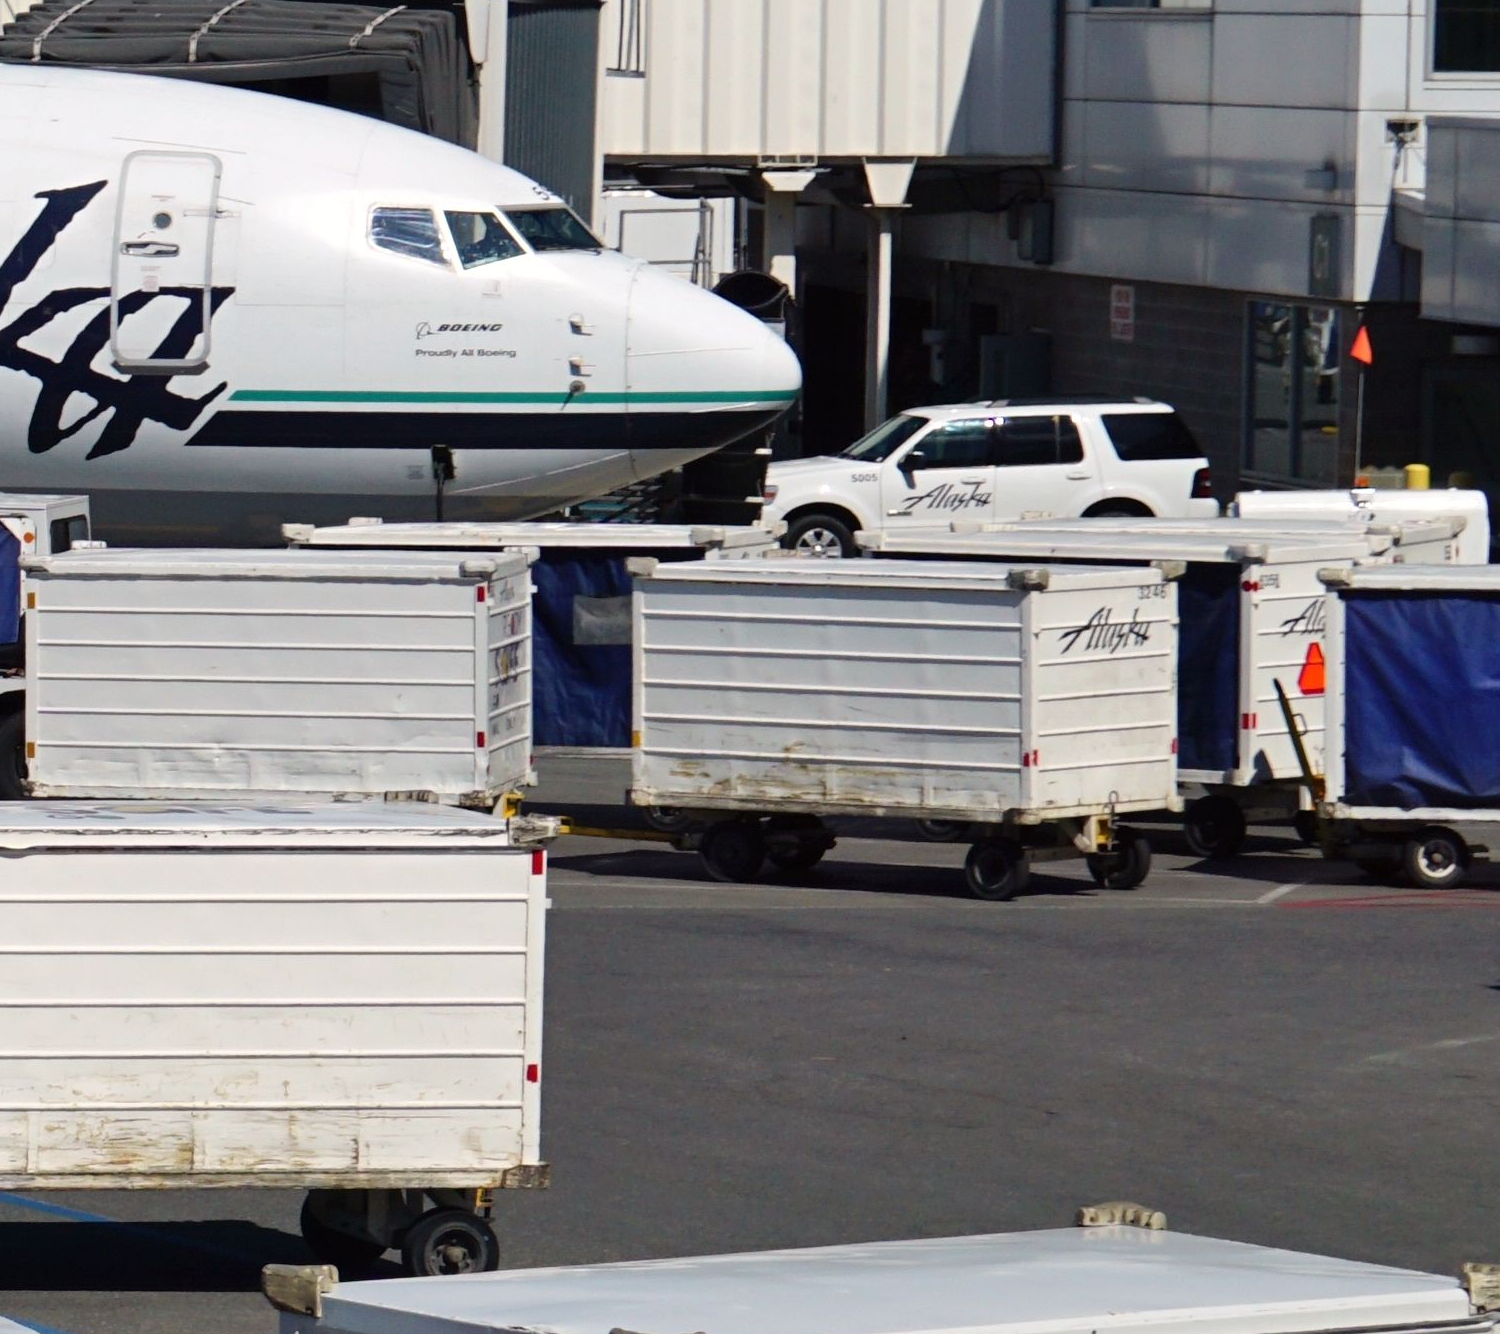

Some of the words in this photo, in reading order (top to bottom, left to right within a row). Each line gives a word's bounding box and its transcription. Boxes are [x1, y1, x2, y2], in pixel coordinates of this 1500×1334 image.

[437, 322, 504, 333] BOEING
[415, 348, 457, 360] Proudly
[461, 348, 475, 357] All
[477, 348, 517, 360] Boeing
[904, 481, 993, 512] Alaska
[1058, 605, 1151, 655] Alaska
